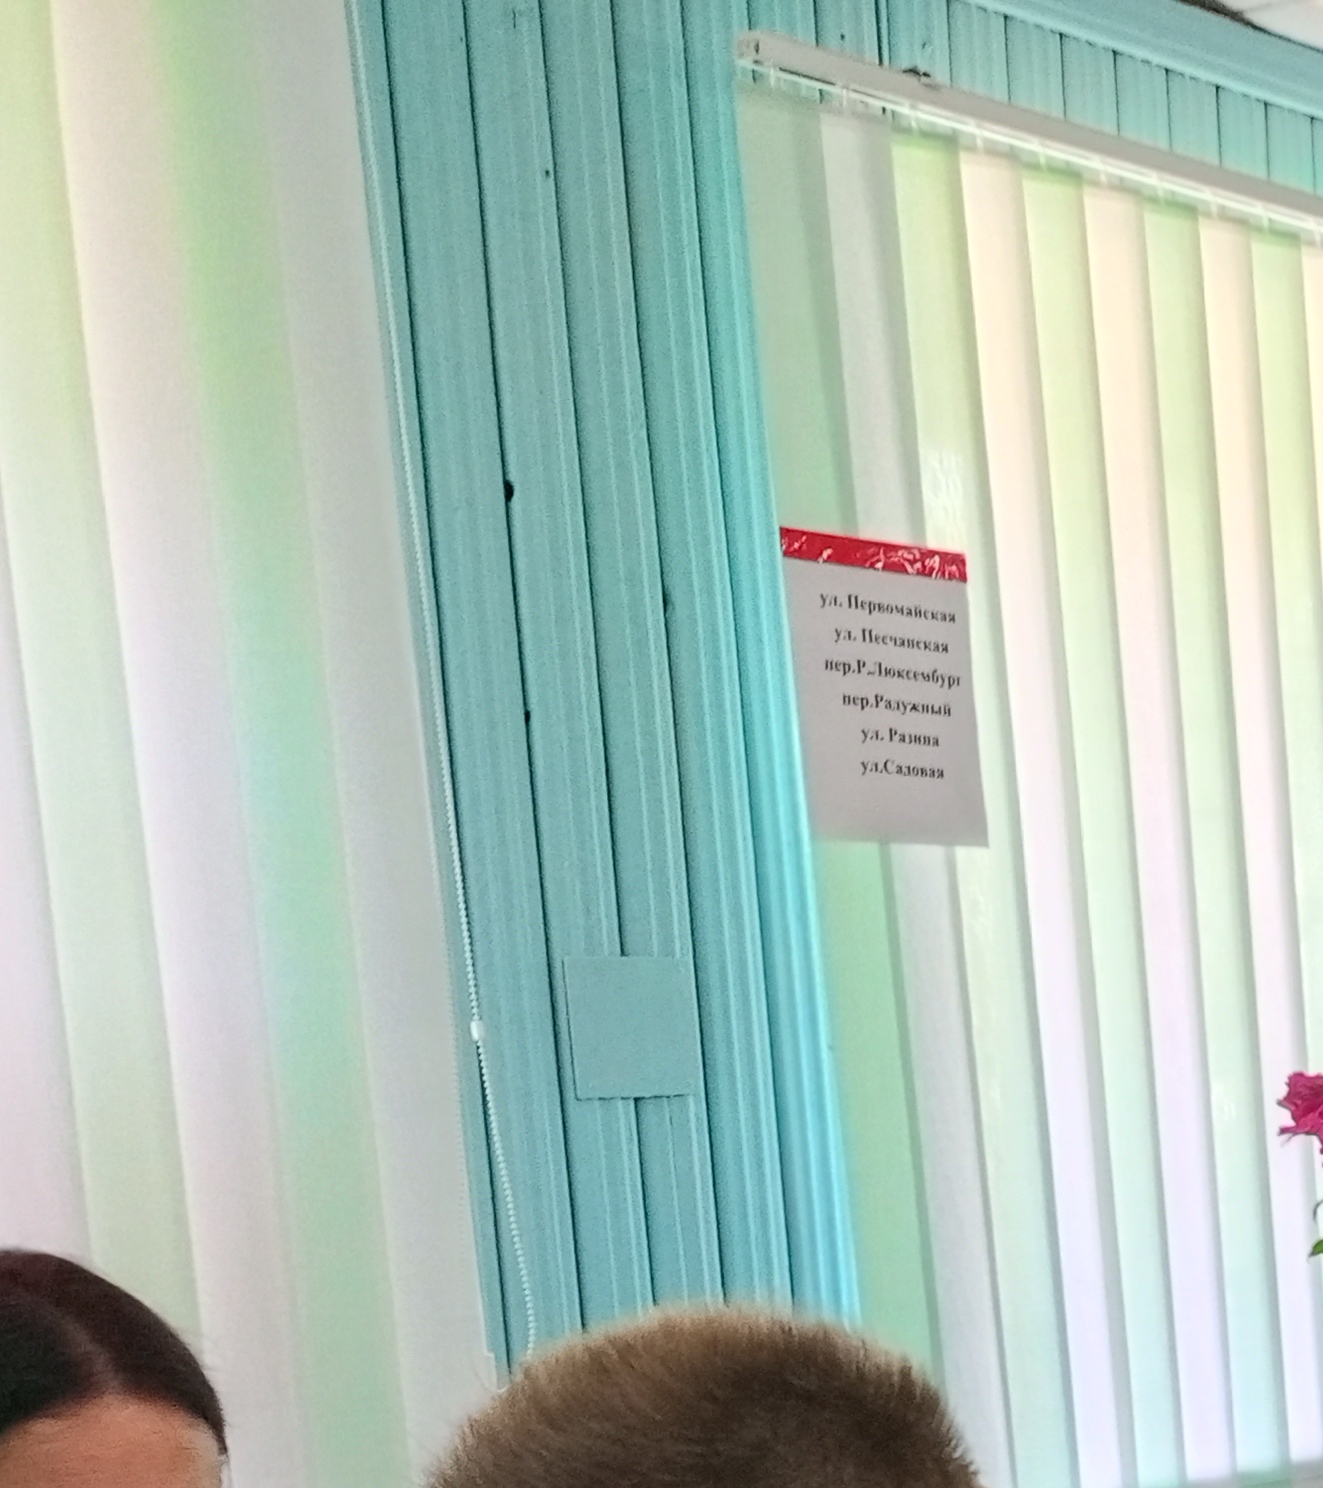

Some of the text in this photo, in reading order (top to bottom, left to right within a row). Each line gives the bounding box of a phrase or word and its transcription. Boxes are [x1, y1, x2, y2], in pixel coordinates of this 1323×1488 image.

[820, 592, 957, 624] ул. Первомайская
[834, 627, 949, 654] ул. Песчанская
[860, 727, 940, 747] ул. Разина
